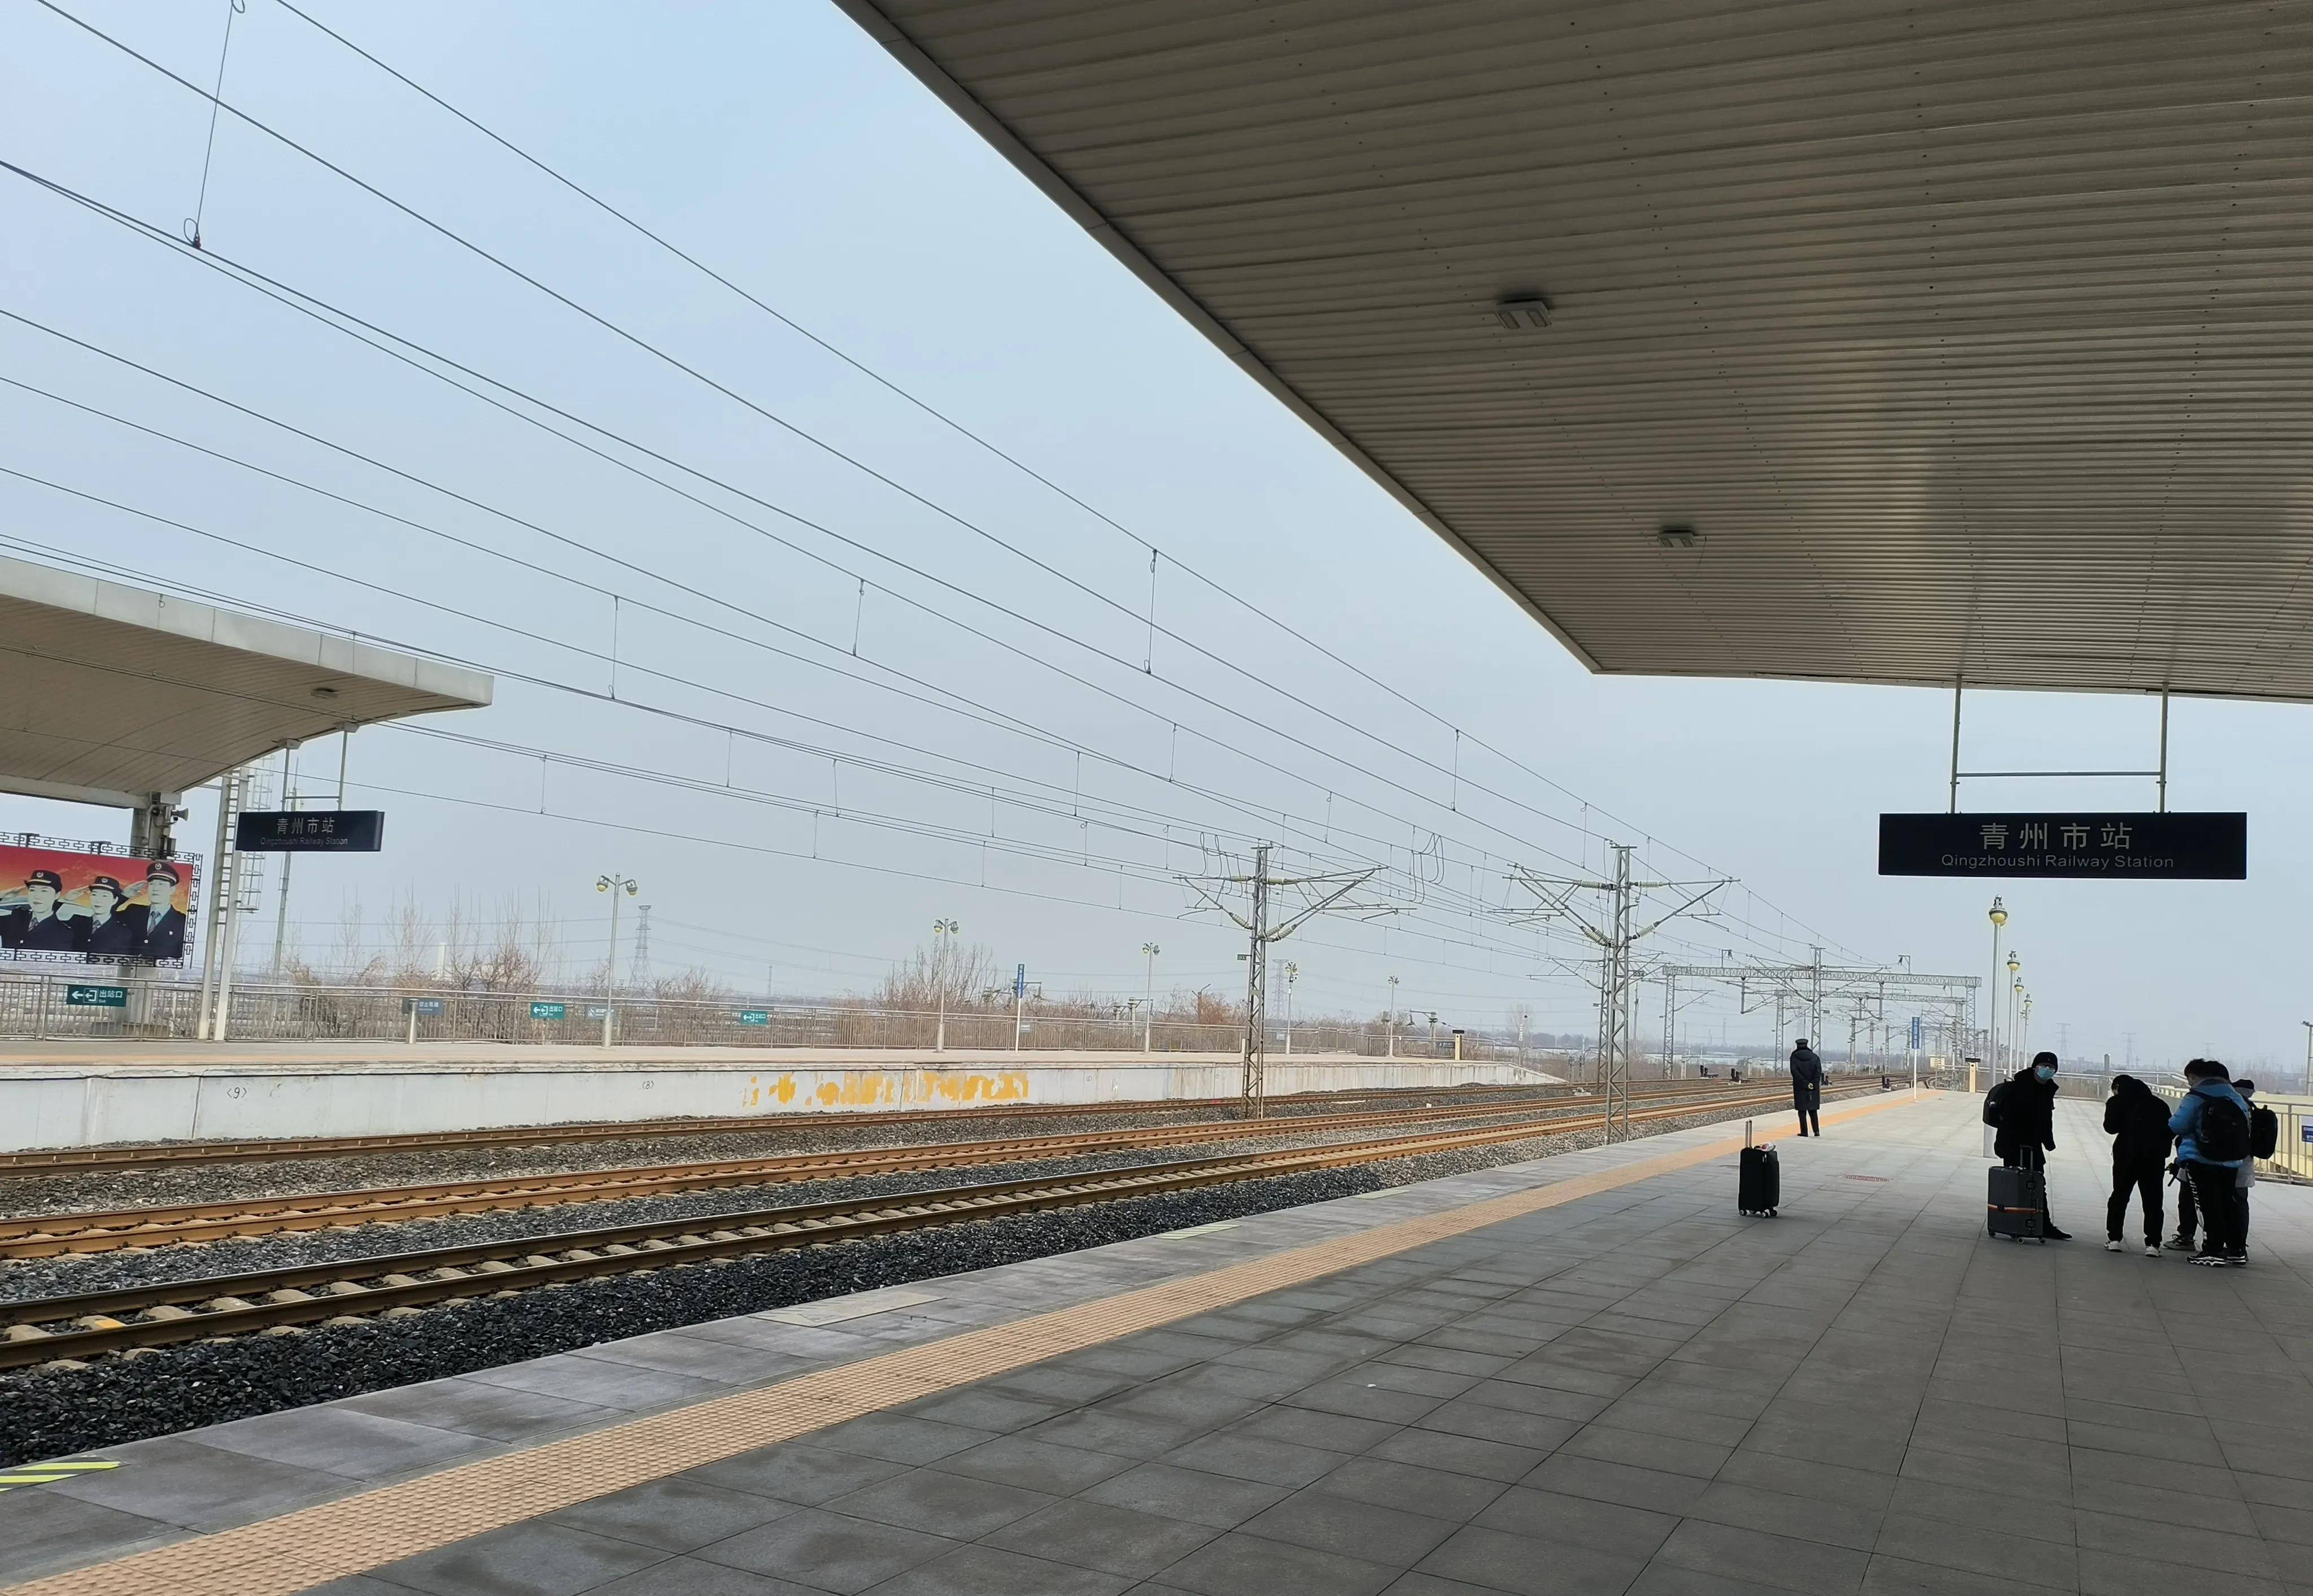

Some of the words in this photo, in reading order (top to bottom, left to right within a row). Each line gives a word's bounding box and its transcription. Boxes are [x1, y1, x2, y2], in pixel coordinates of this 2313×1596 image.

[276, 817, 335, 835] 青州市站
[300, 838, 324, 847] Railway
[1979, 822, 2133, 851] 青州市站
[1941, 854, 2041, 870] Qingzhoushi
[2045, 854, 2109, 871] Railway
[2114, 854, 2174, 869] Station
[99, 989, 123, 998] 出站口
